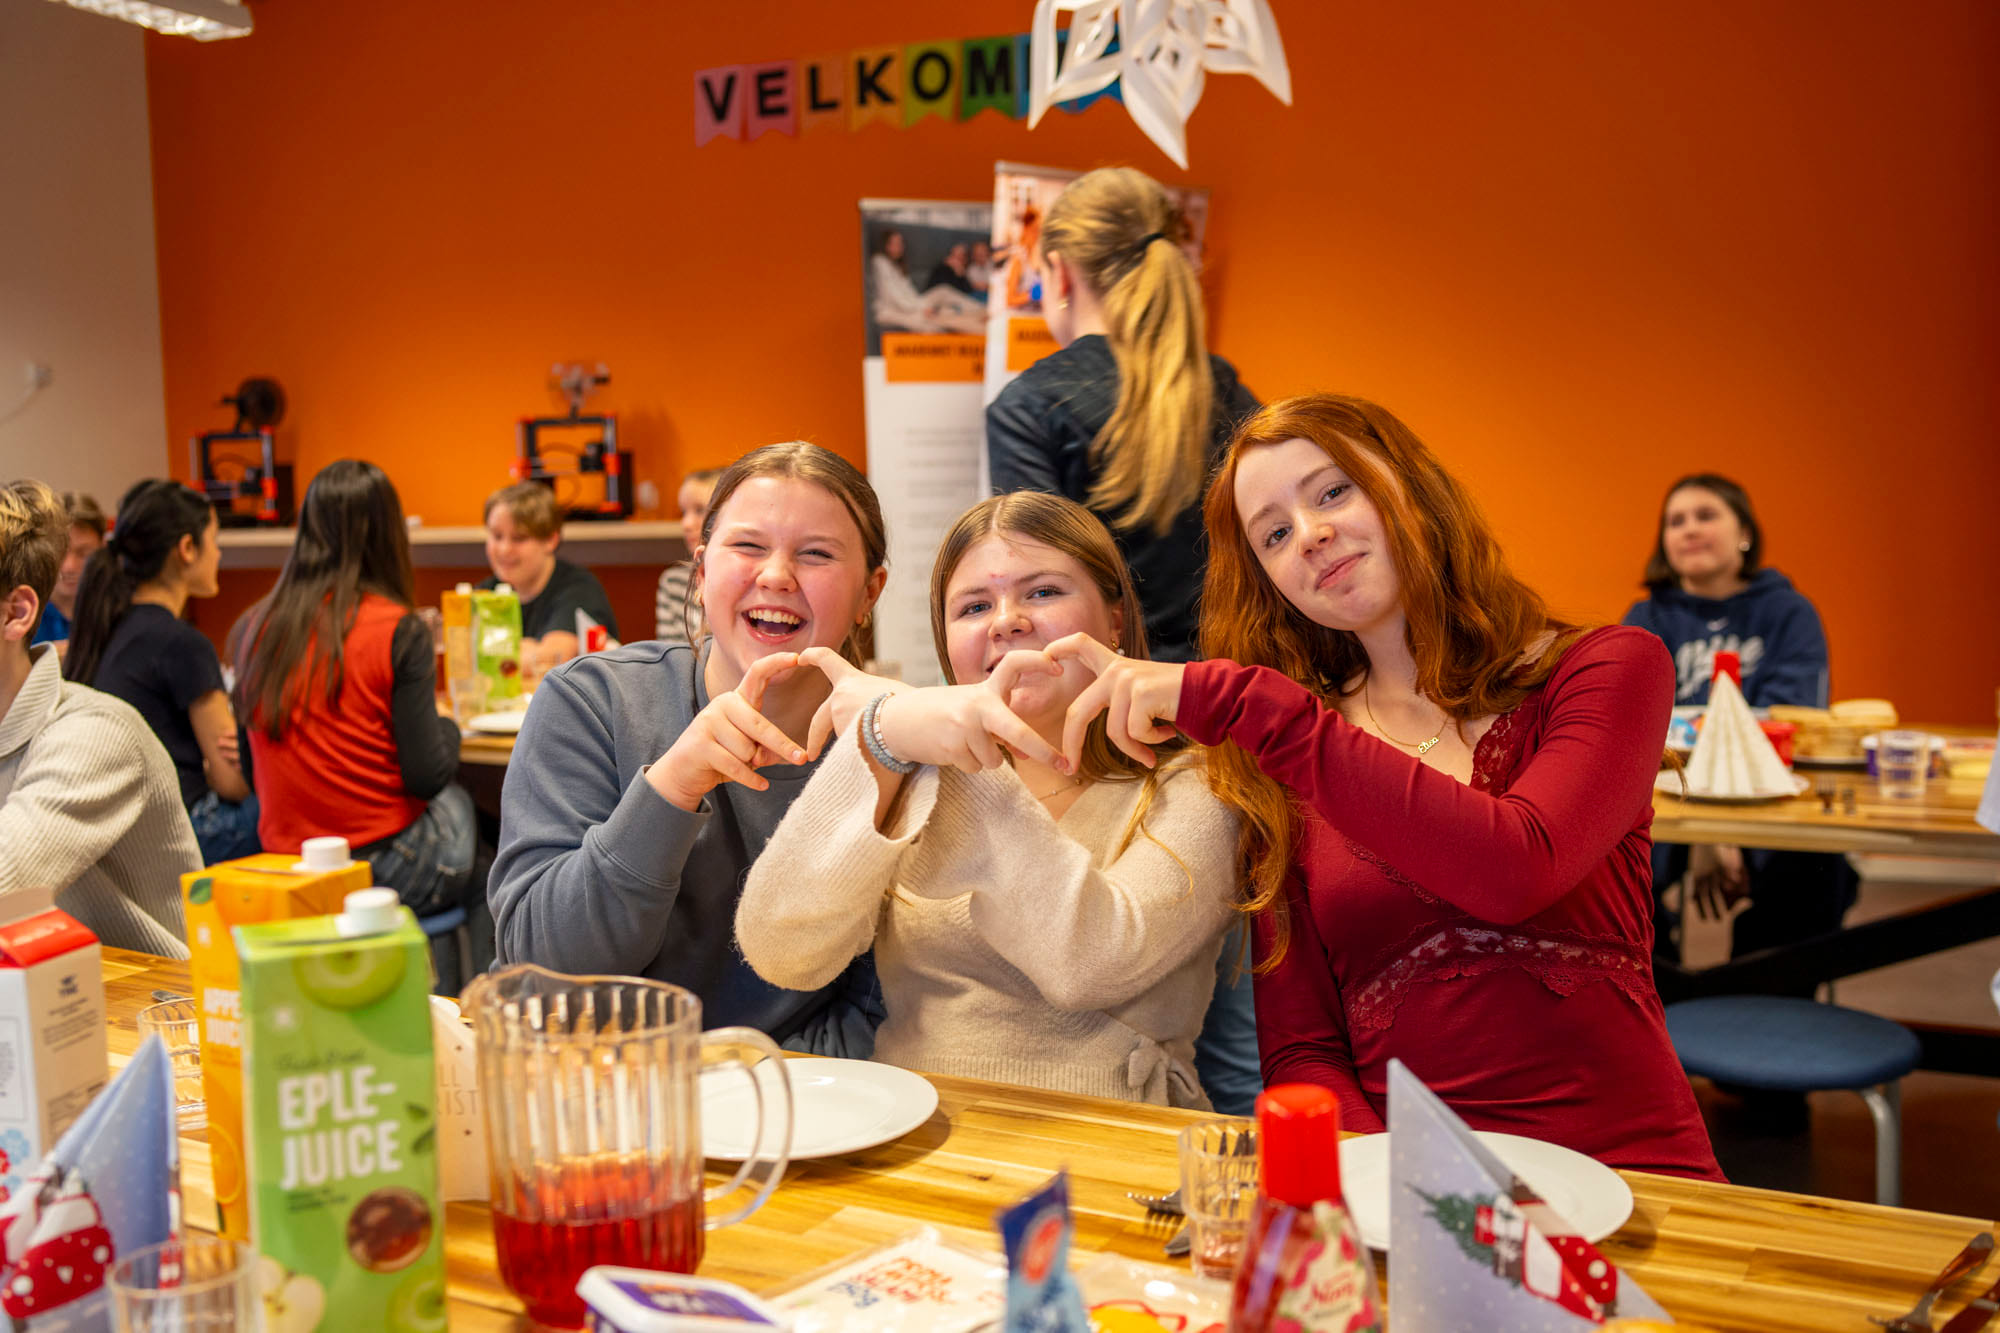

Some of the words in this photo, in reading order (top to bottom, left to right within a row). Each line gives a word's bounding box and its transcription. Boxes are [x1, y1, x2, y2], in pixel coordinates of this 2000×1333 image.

[701, 38, 1119, 122] VELKOM
[279, 1065, 397, 1130] EPLE-
[280, 1119, 403, 1191] JUICE
